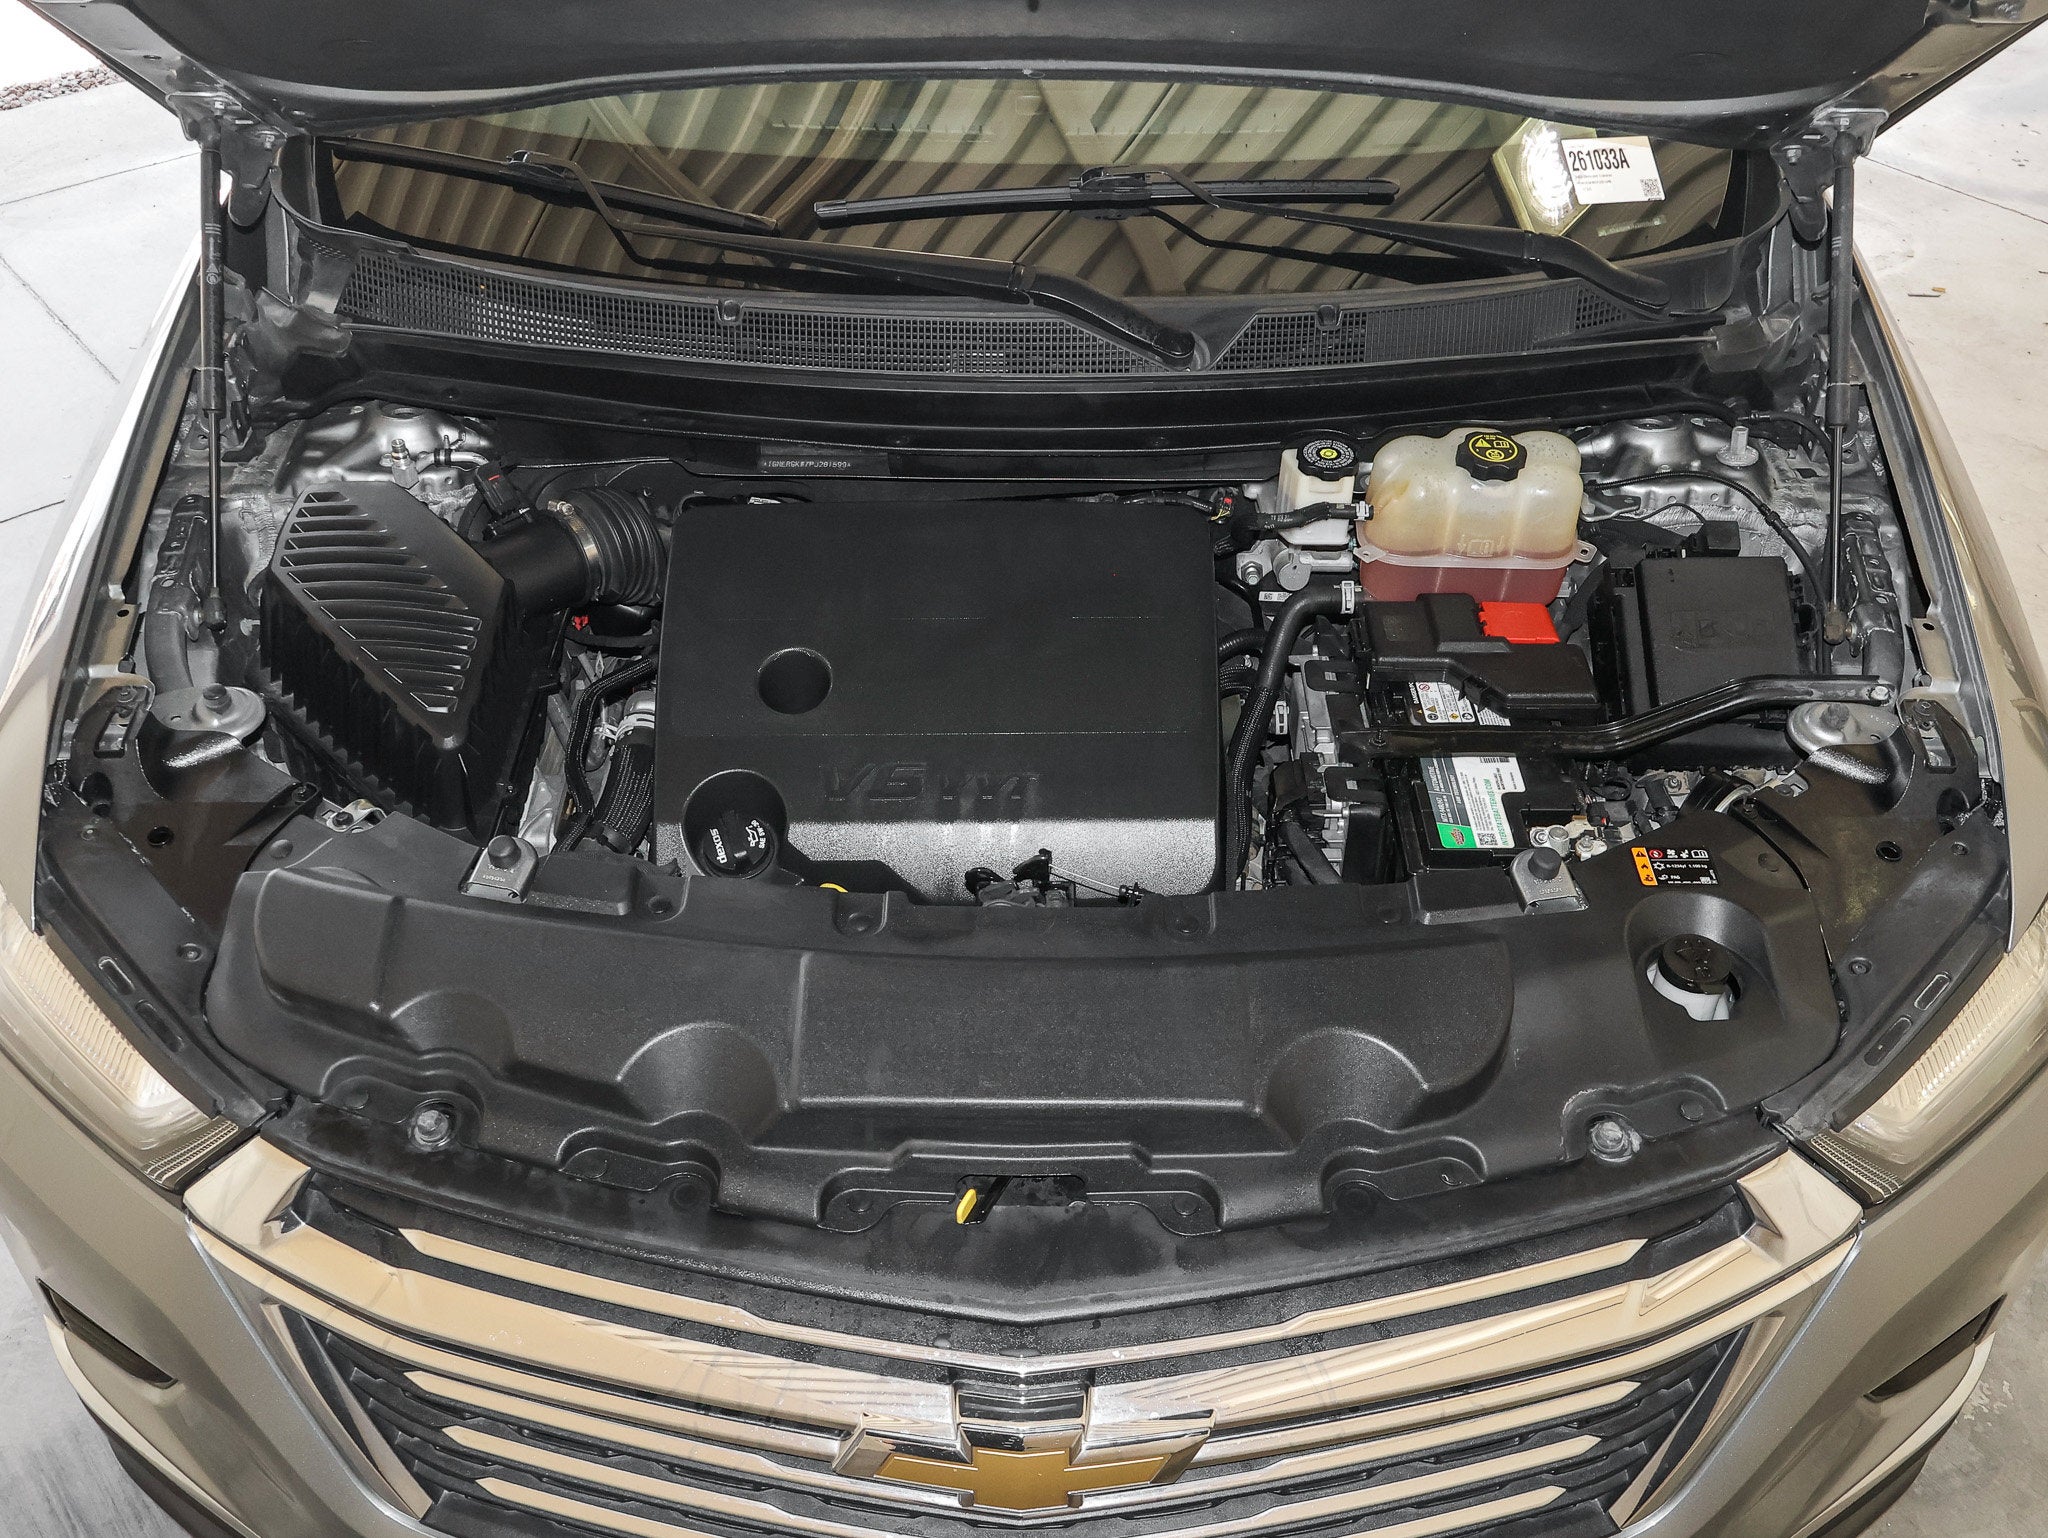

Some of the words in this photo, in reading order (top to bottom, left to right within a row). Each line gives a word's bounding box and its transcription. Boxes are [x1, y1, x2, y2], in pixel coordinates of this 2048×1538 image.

[1568, 147, 1630, 172] 261033A
[818, 761, 927, 801] V6
[709, 828, 728, 864] dexos
